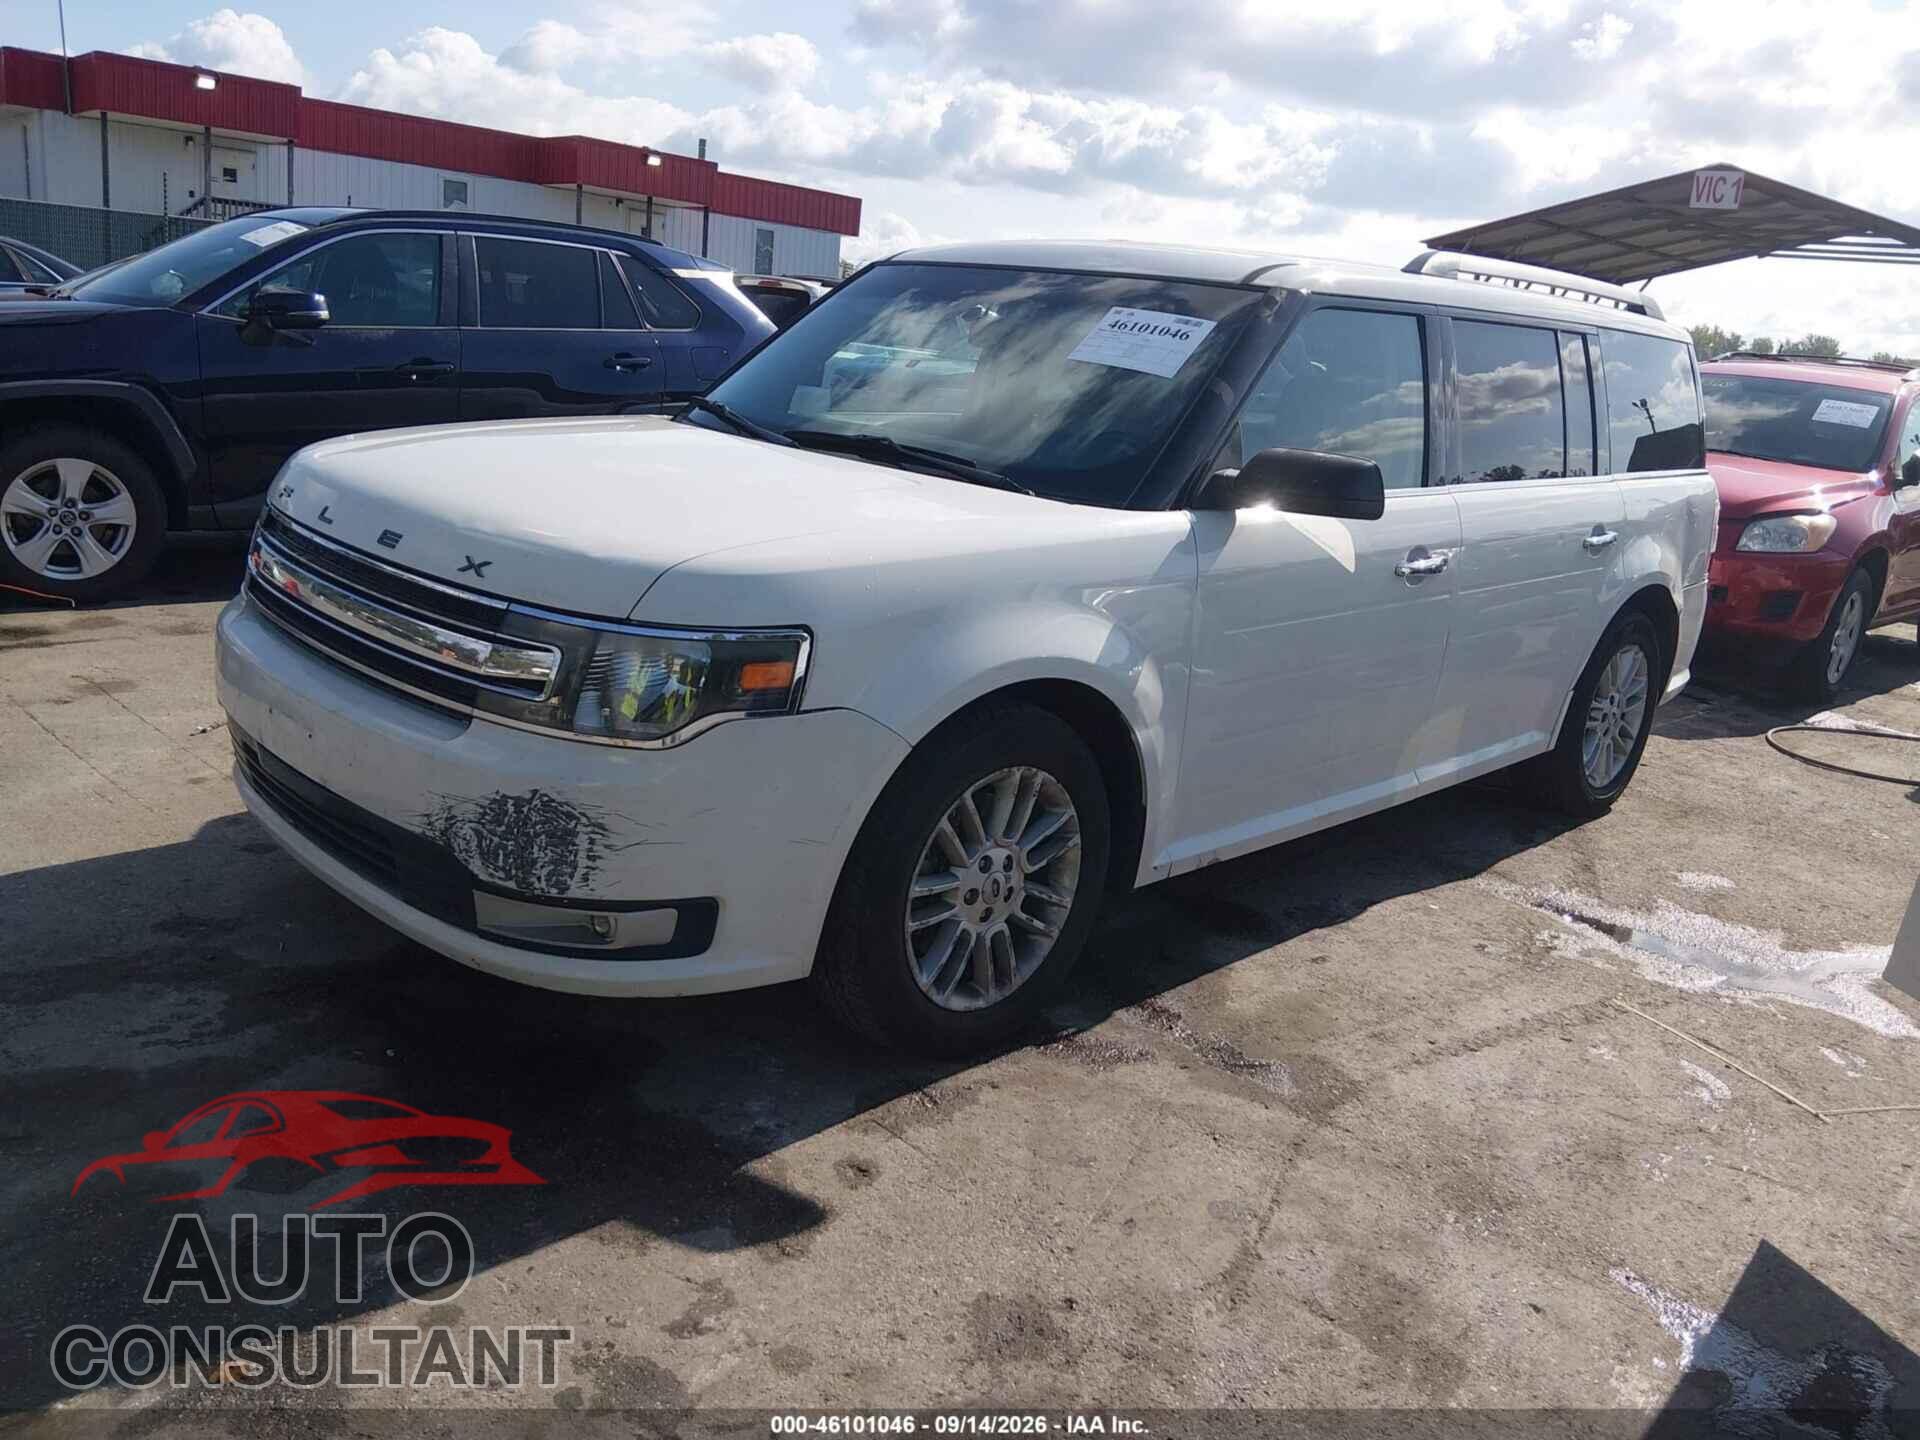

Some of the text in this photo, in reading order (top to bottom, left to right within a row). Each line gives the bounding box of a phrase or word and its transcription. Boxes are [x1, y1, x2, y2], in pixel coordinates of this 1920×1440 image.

[1695, 176, 1743, 204] VIC 1
[1108, 319, 1192, 341] 46101046
